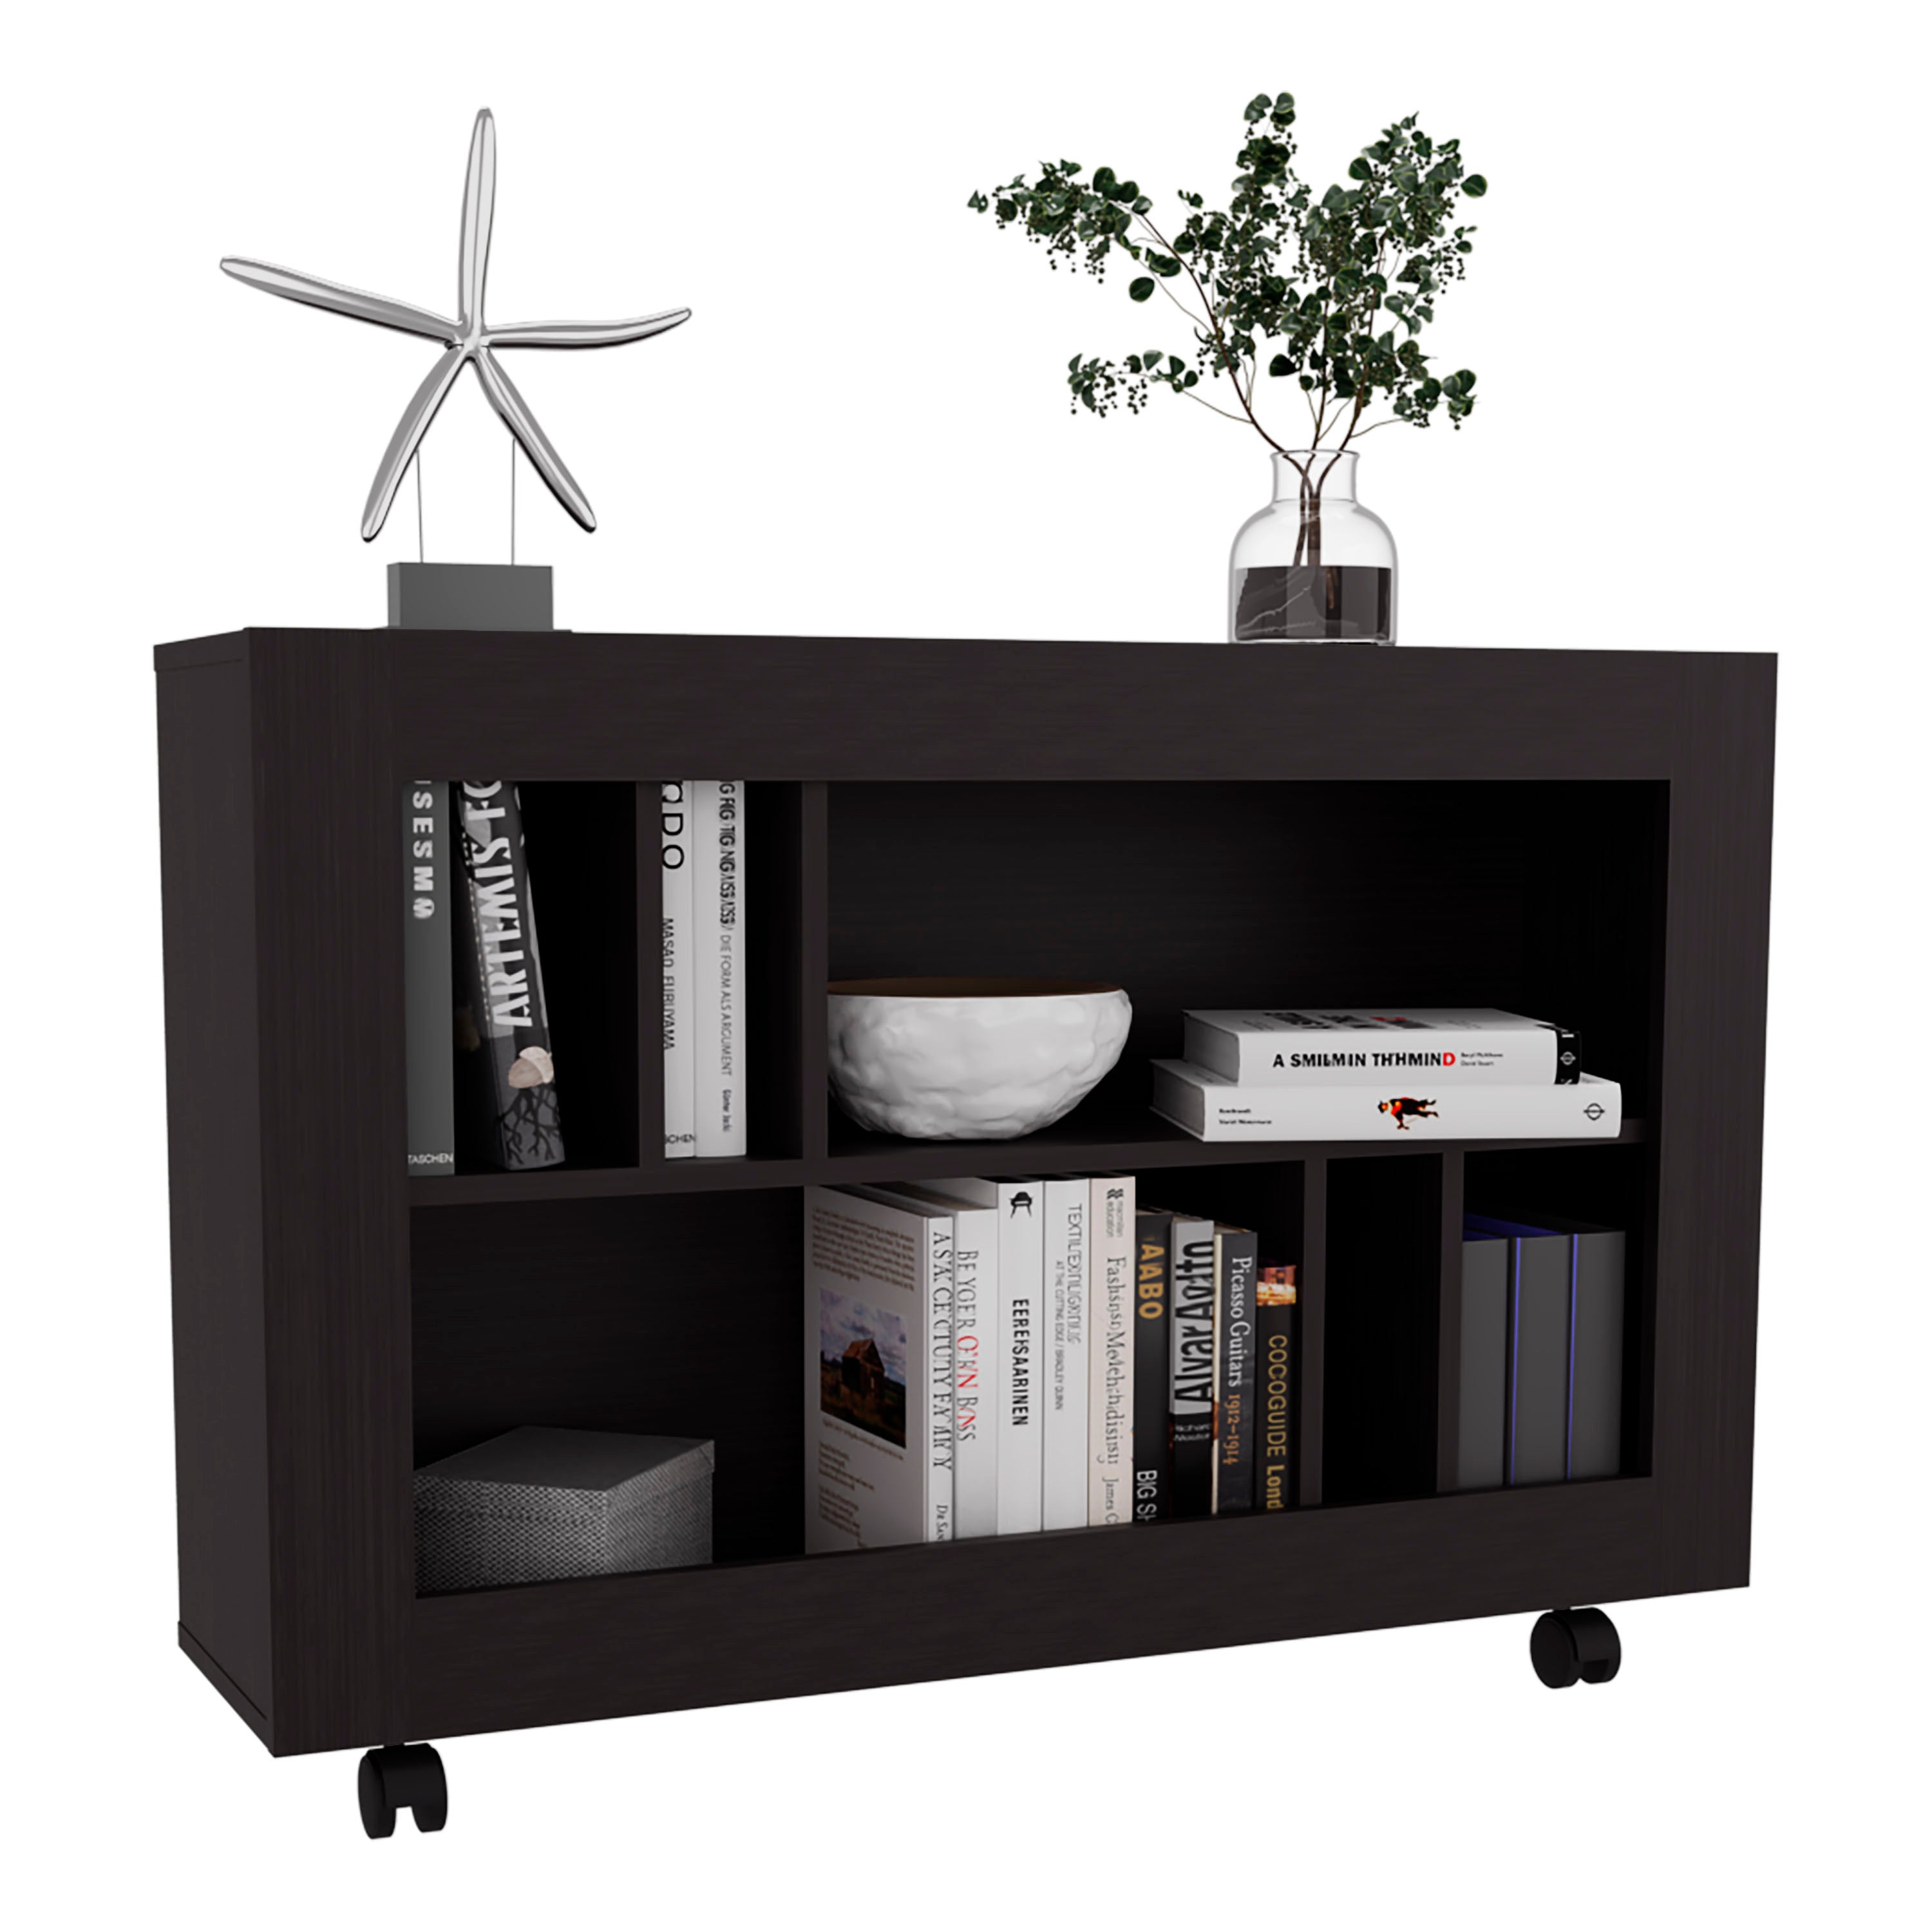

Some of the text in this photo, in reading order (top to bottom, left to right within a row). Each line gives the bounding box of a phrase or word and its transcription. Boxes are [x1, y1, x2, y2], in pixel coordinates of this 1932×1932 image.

[469, 837, 533, 1027] ARTEMIS
[720, 935, 732, 953] DIE
[720, 955, 733, 988] FORM
[721, 990, 733, 1011] ALS
[721, 1013, 734, 1076] ARGUMENT
[408, 1153, 453, 1166] TASCHEN
[1230, 1256, 1253, 1318] Picasso
[1174, 1325, 1213, 1403] Alvar
[1228, 1321, 1253, 1388] Guitars
[1266, 1334, 1288, 1458] COCOGUIDE
[1136, 1469, 1158, 1504] BIG
